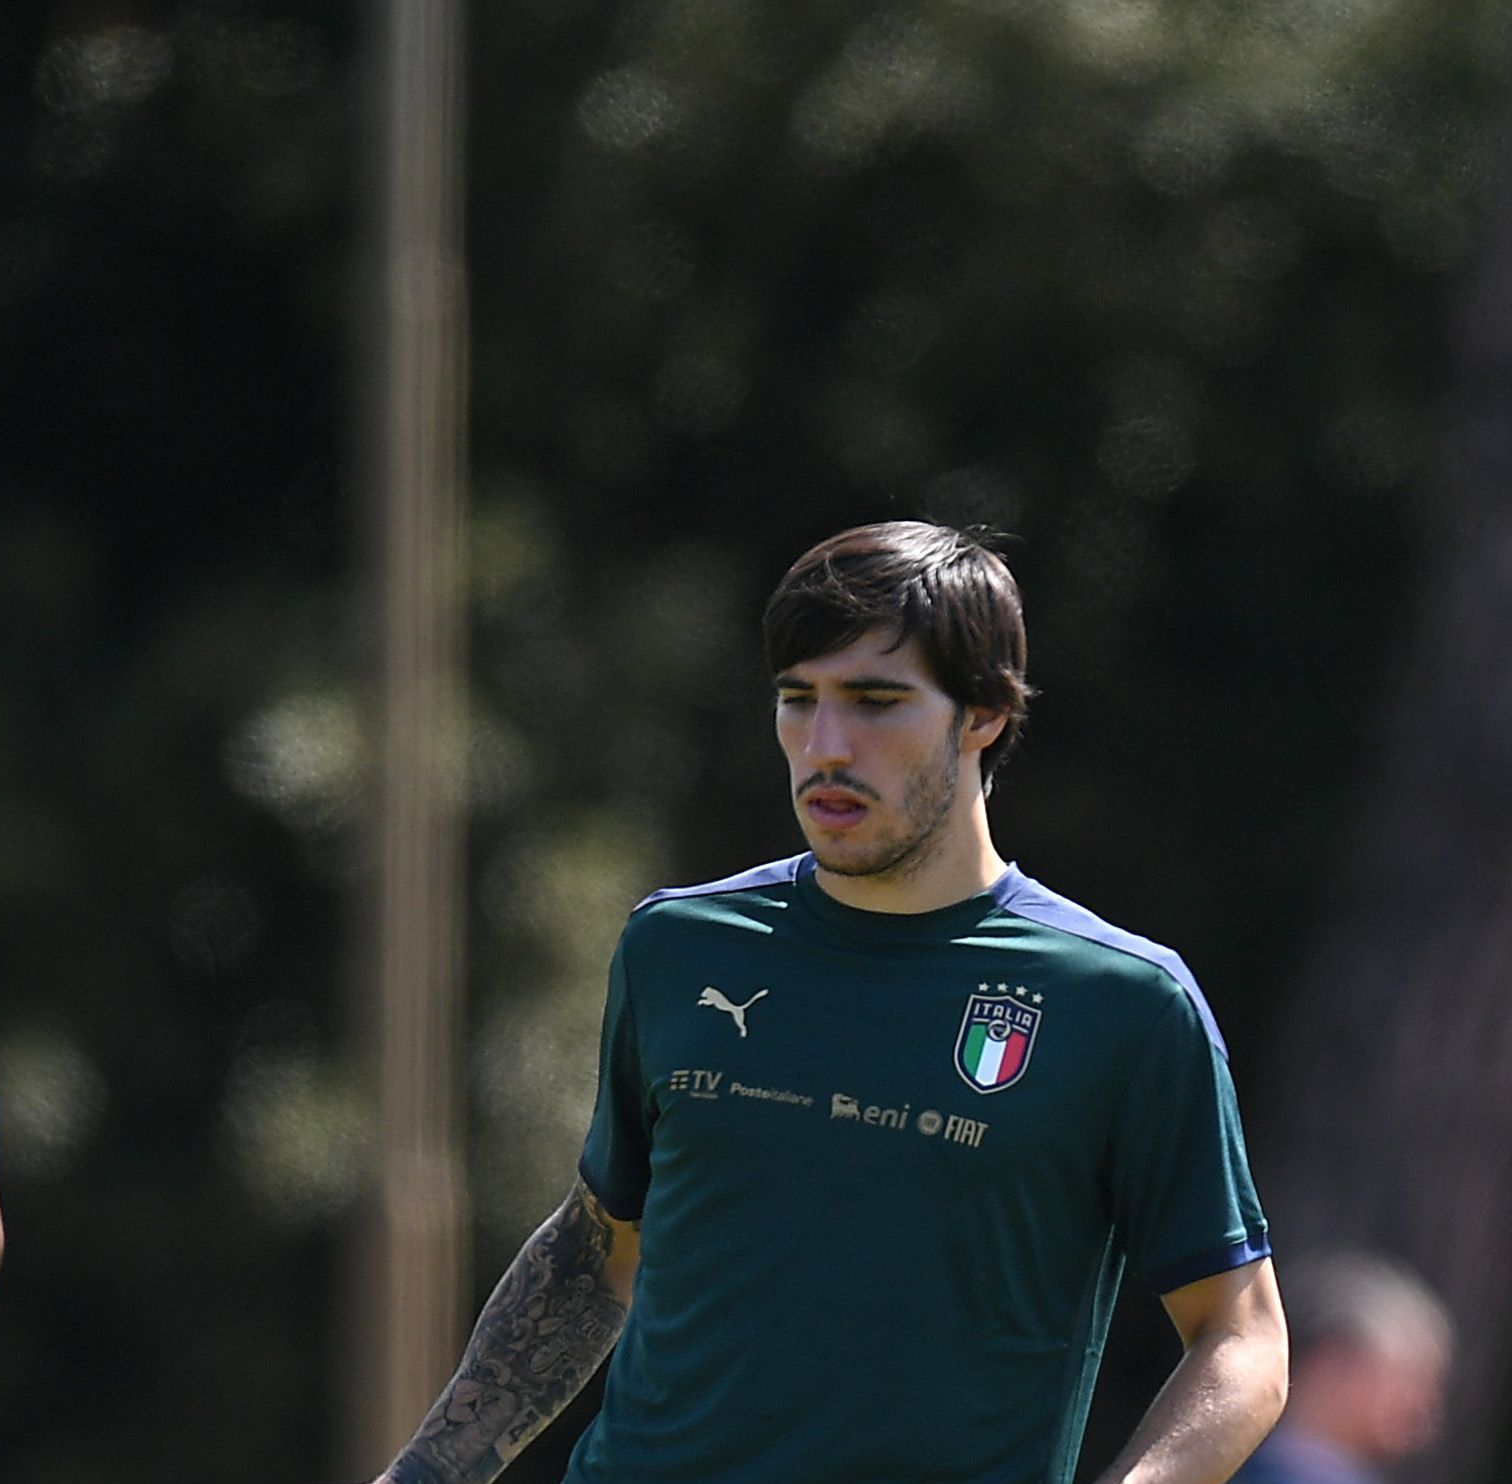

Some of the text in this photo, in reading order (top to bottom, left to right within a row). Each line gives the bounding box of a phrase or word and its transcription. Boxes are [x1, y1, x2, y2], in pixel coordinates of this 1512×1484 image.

[973, 1002, 1034, 1028] ITALIA
[691, 1069, 724, 1091] TV
[862, 1102, 912, 1130] eni
[943, 1113, 989, 1149] FIAT
